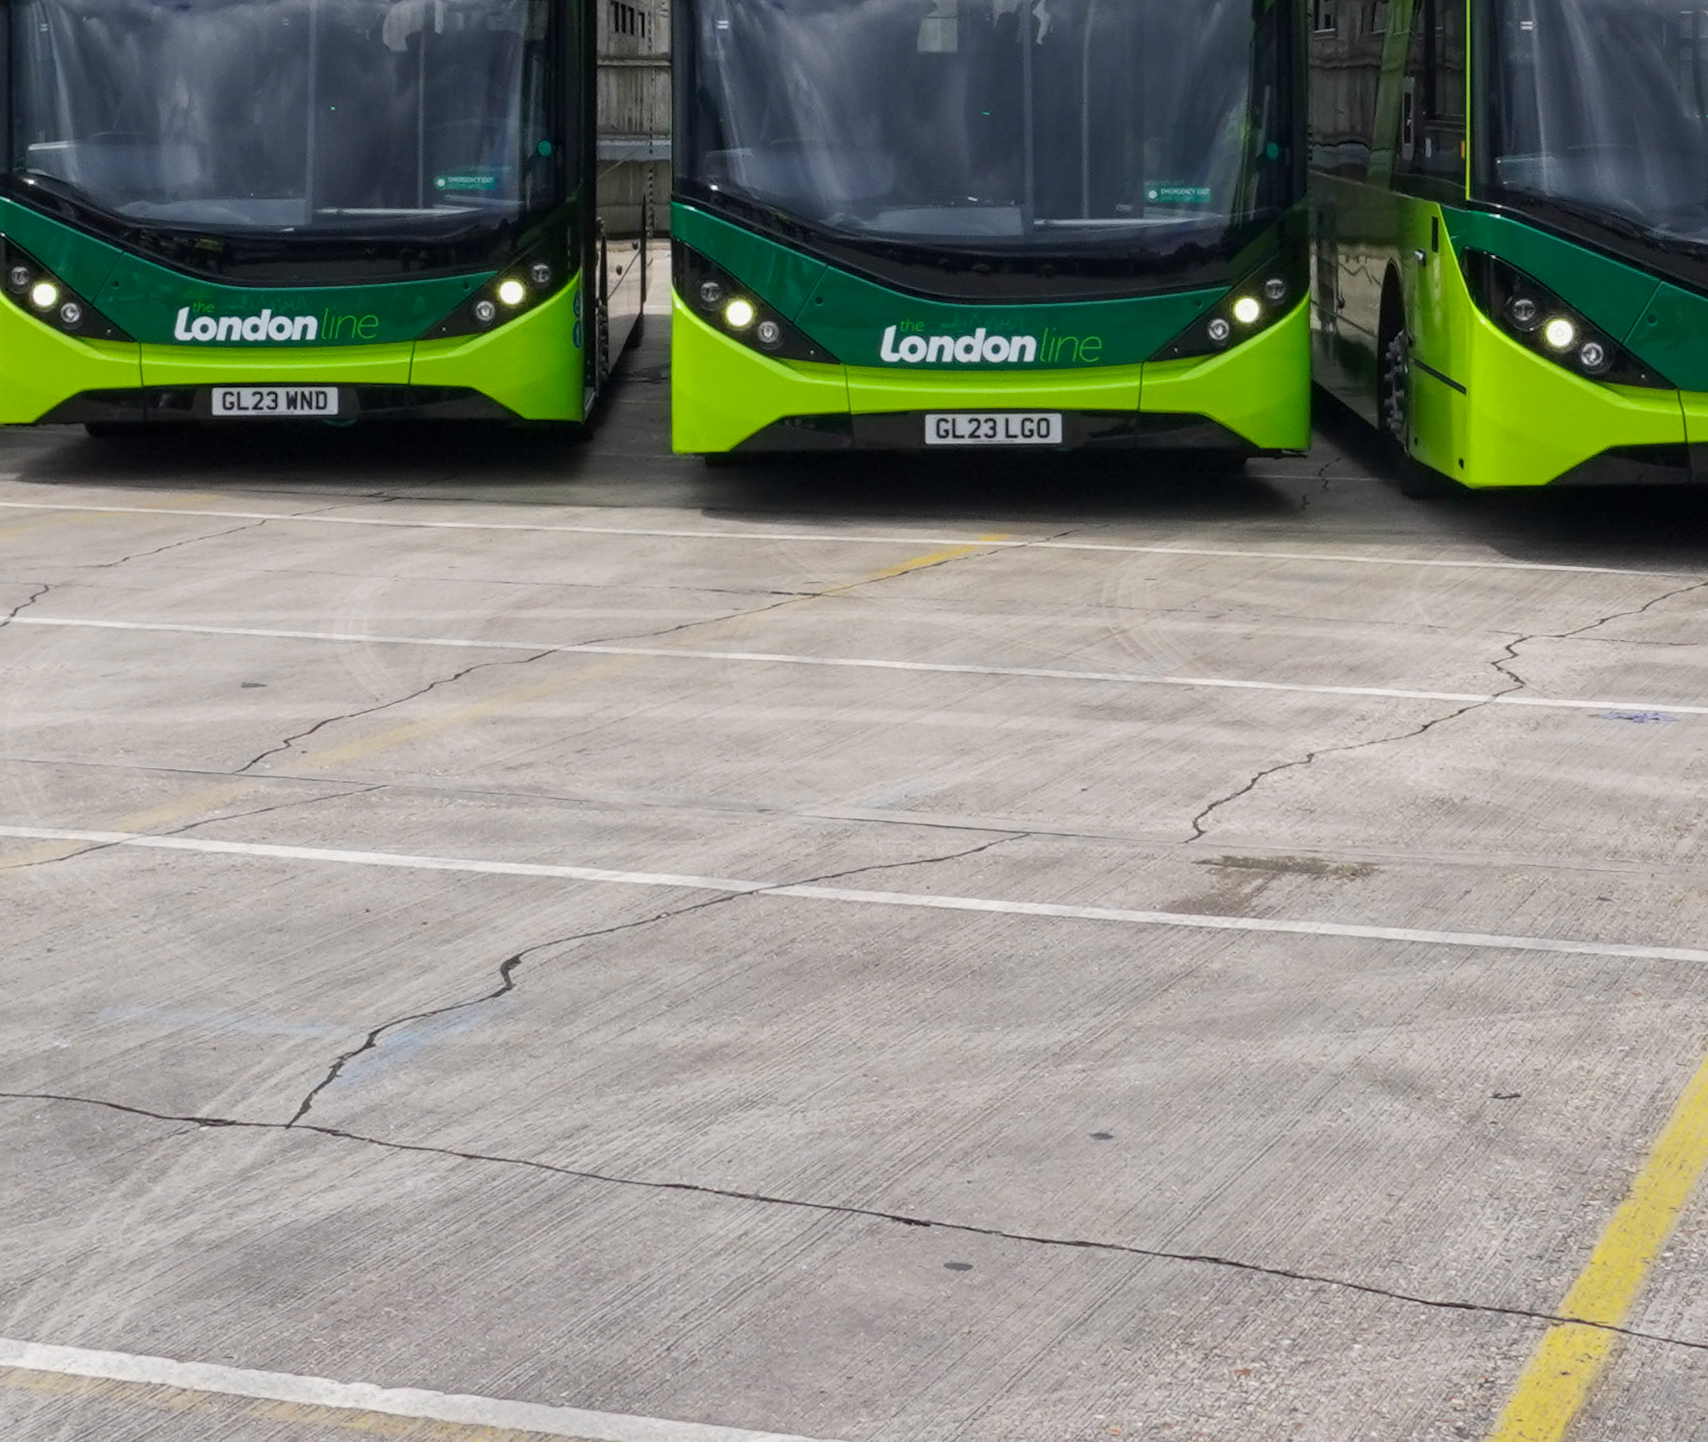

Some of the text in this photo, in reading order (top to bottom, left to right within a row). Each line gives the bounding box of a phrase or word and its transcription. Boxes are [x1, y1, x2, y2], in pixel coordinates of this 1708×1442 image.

[192, 301, 216, 314] the
[173, 306, 319, 342] London
[899, 317, 925, 333] the
[879, 324, 1037, 364] London
[222, 391, 328, 411] GL23 WND
[935, 418, 1051, 439] GL23 LGO
